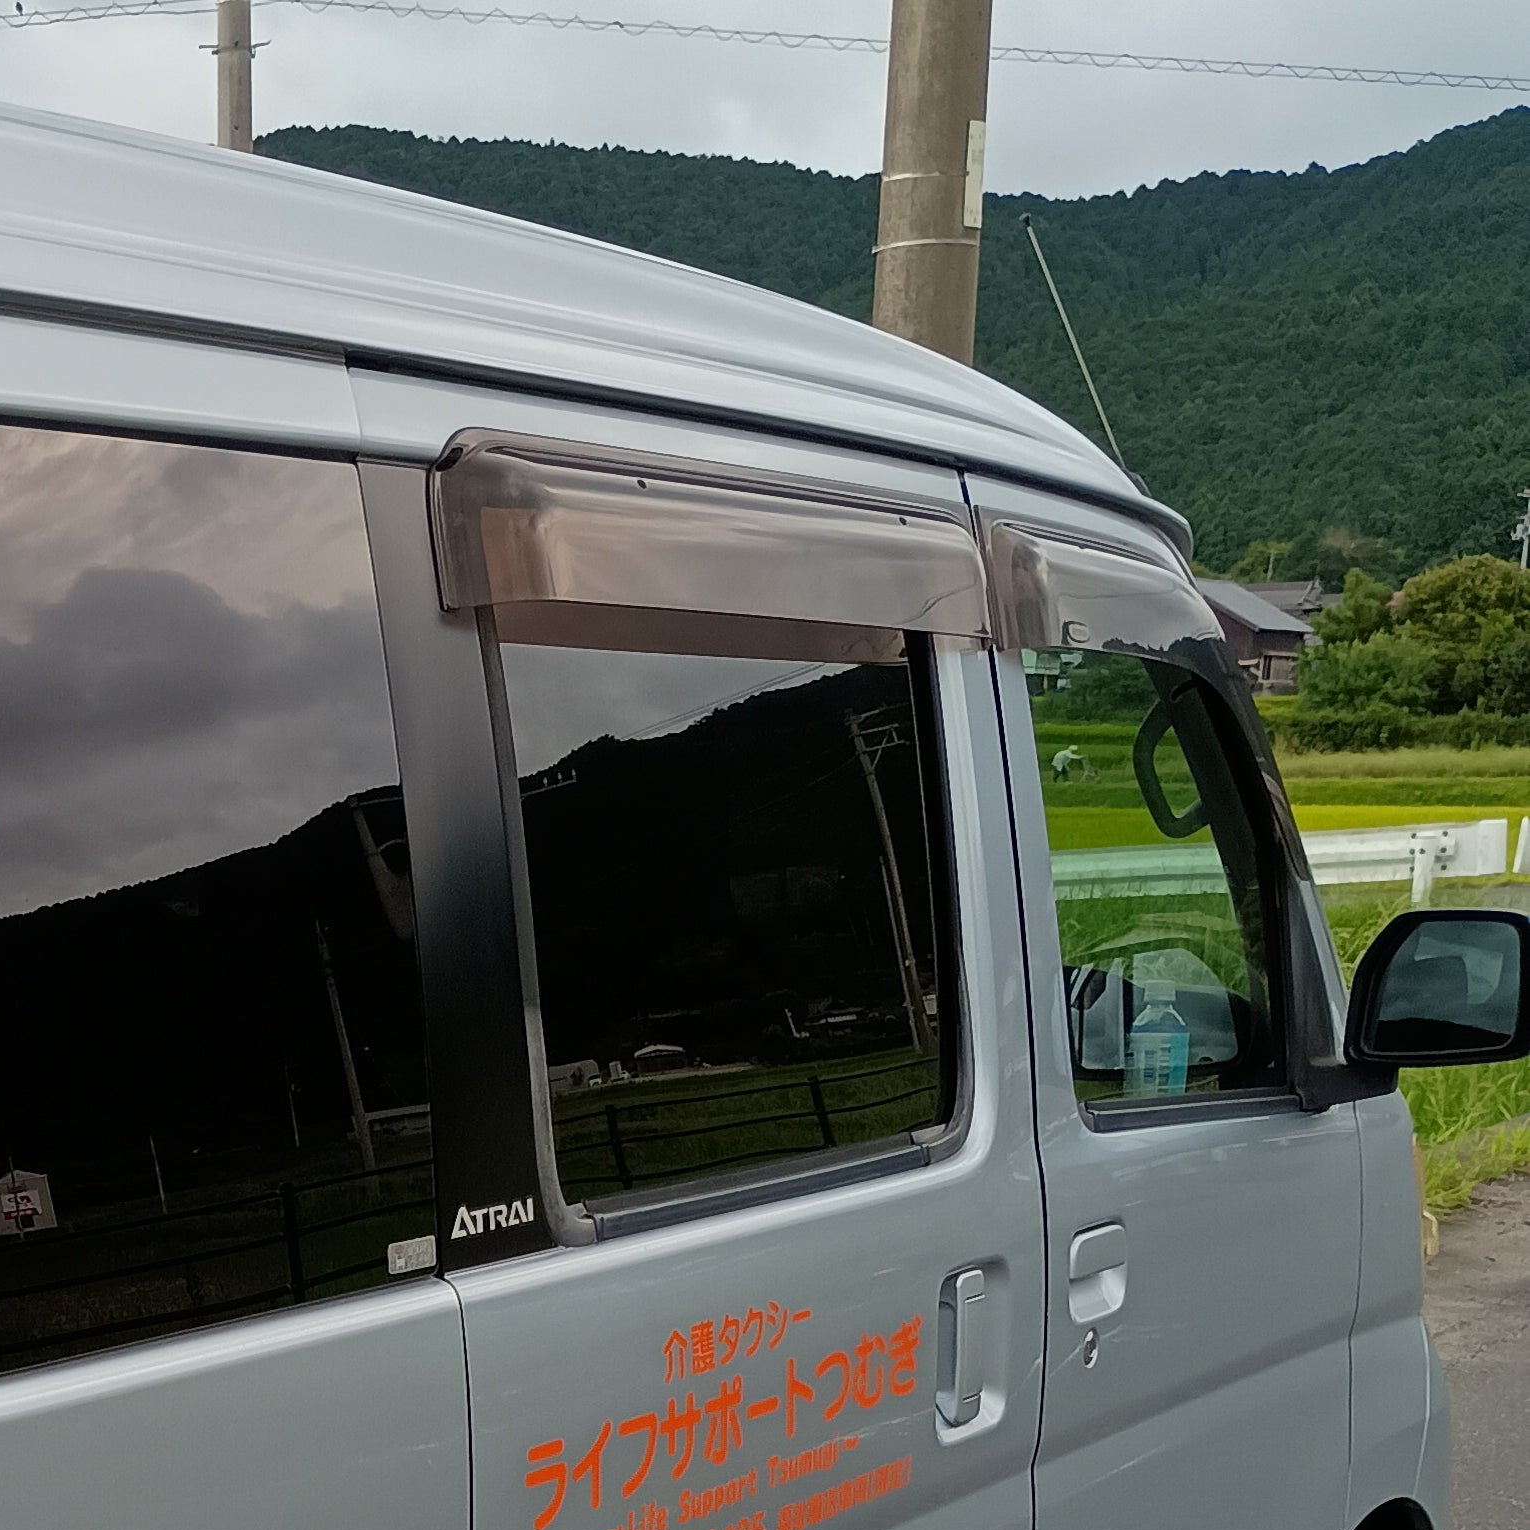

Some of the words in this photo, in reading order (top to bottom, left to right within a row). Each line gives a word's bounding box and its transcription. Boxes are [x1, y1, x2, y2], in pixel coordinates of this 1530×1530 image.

[451, 1197, 535, 1240] ATRAI
[661, 1301, 812, 1384] 介護タクシー
[677, 1467, 758, 1525] Support
